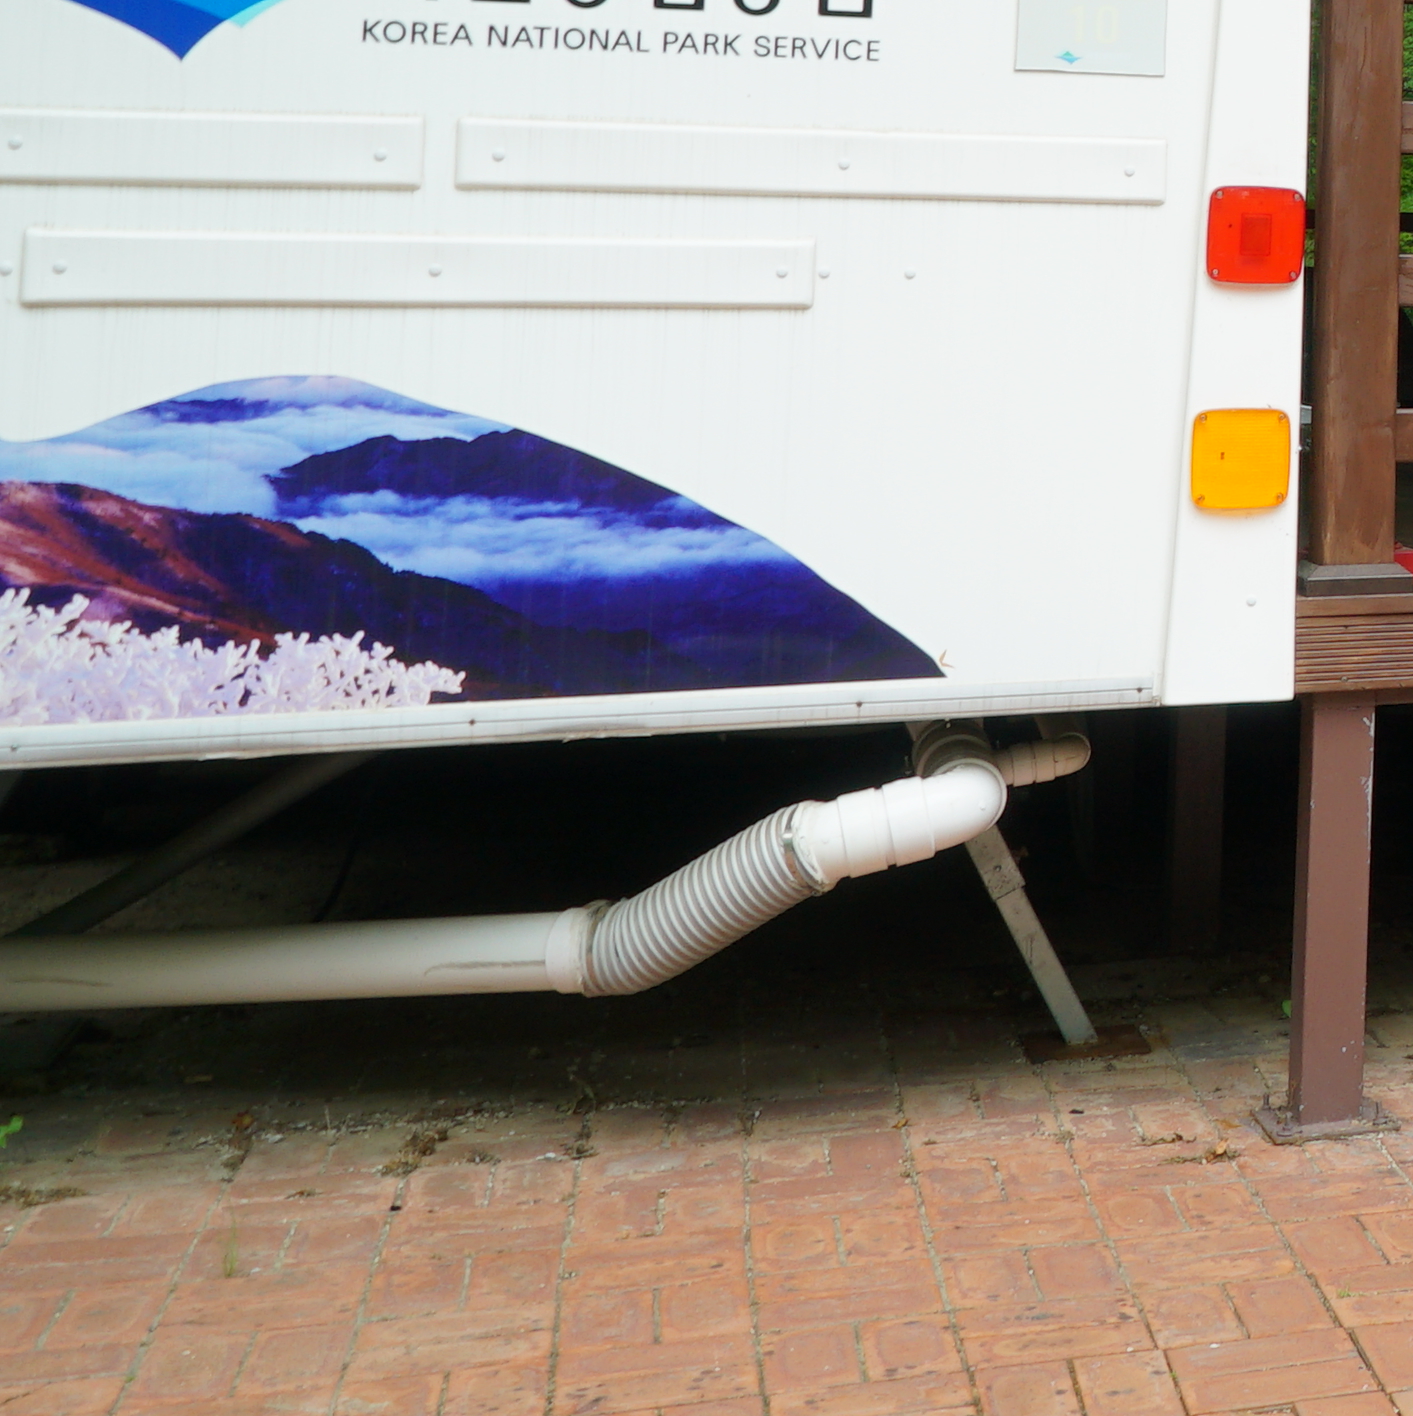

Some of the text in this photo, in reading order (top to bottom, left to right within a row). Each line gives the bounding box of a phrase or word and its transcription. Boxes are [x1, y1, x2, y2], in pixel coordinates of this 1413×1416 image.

[362, 19, 881, 62] KOREA NATIONAL PARK SERVICE
[1068, 5, 1119, 44] 10
